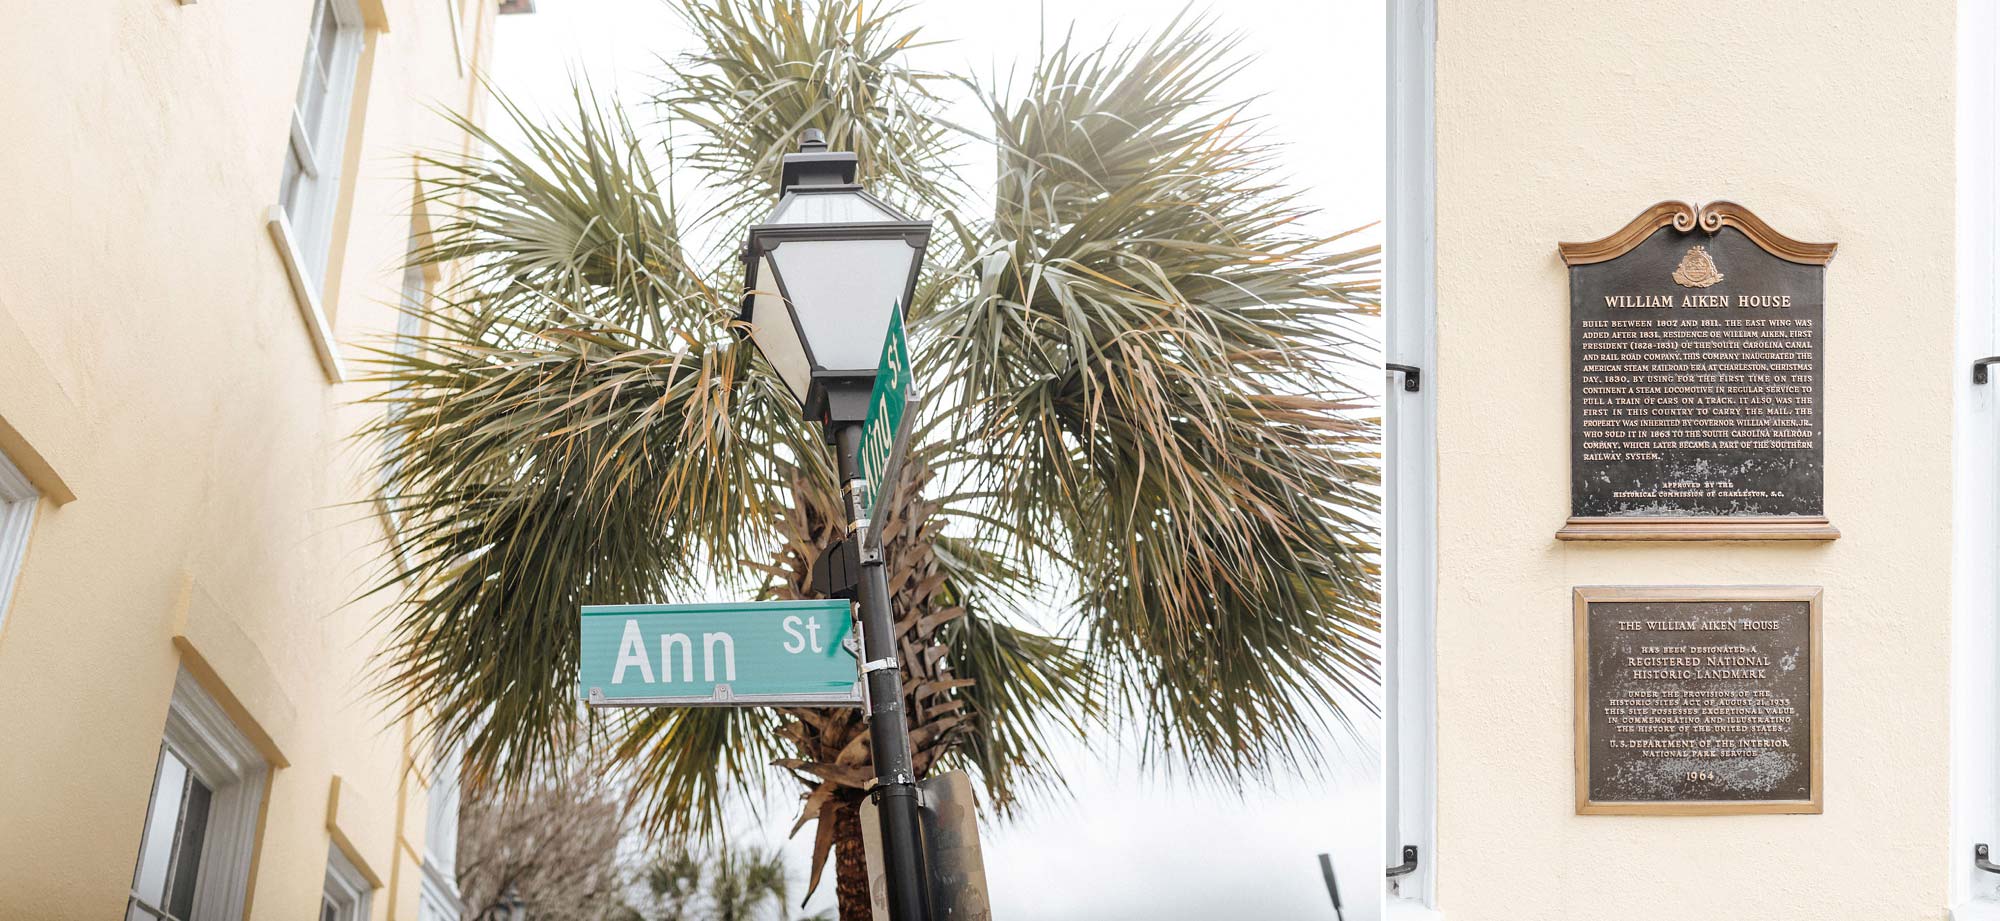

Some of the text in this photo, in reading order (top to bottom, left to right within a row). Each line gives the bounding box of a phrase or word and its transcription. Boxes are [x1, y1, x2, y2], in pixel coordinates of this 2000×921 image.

[1605, 295, 1791, 308] WILLIAM AIKEN HOUSE
[1612, 320, 1652, 328] BETWEEN
[1630, 342, 1678, 350] (1828-1831)
[1600, 353, 1619, 361] RAIL
[1621, 353, 1641, 361] ROAD
[1624, 364, 1649, 372] STEAM
[1751, 397, 1772, 405] ALSO
[1776, 397, 1793, 405] WAS
[1796, 397, 1812, 405] THE
[1626, 408, 1648, 416] THIS
[1652, 408, 1693, 416] COUNTRY
[1696, 408, 1708, 416] TO
[862, 333, 901, 509] King St
[1753, 441, 1769, 449] THE
[1771, 441, 1813, 449] SOUTHERN
[1583, 453, 1621, 461] RAILWAY
[1618, 621, 1780, 631] THE WILLIAM AIKEN HOUSE
[611, 615, 822, 684] Ann St
[1641, 646, 1660, 654] HAS
[1663, 646, 1686, 654] BEEN
[1628, 657, 1771, 666] REGISTERED NATIONAL
[1633, 669, 1766, 679] HISTORIC LANDMARK
[1754, 690, 1770, 698] THE
[1616, 725, 1634, 733] THE
[1629, 740, 1790, 748] DEPARTMENT OF THE INTERIOR
[1642, 750, 1688, 758] NATIONAL
[1686, 770, 1714, 782] 1964
